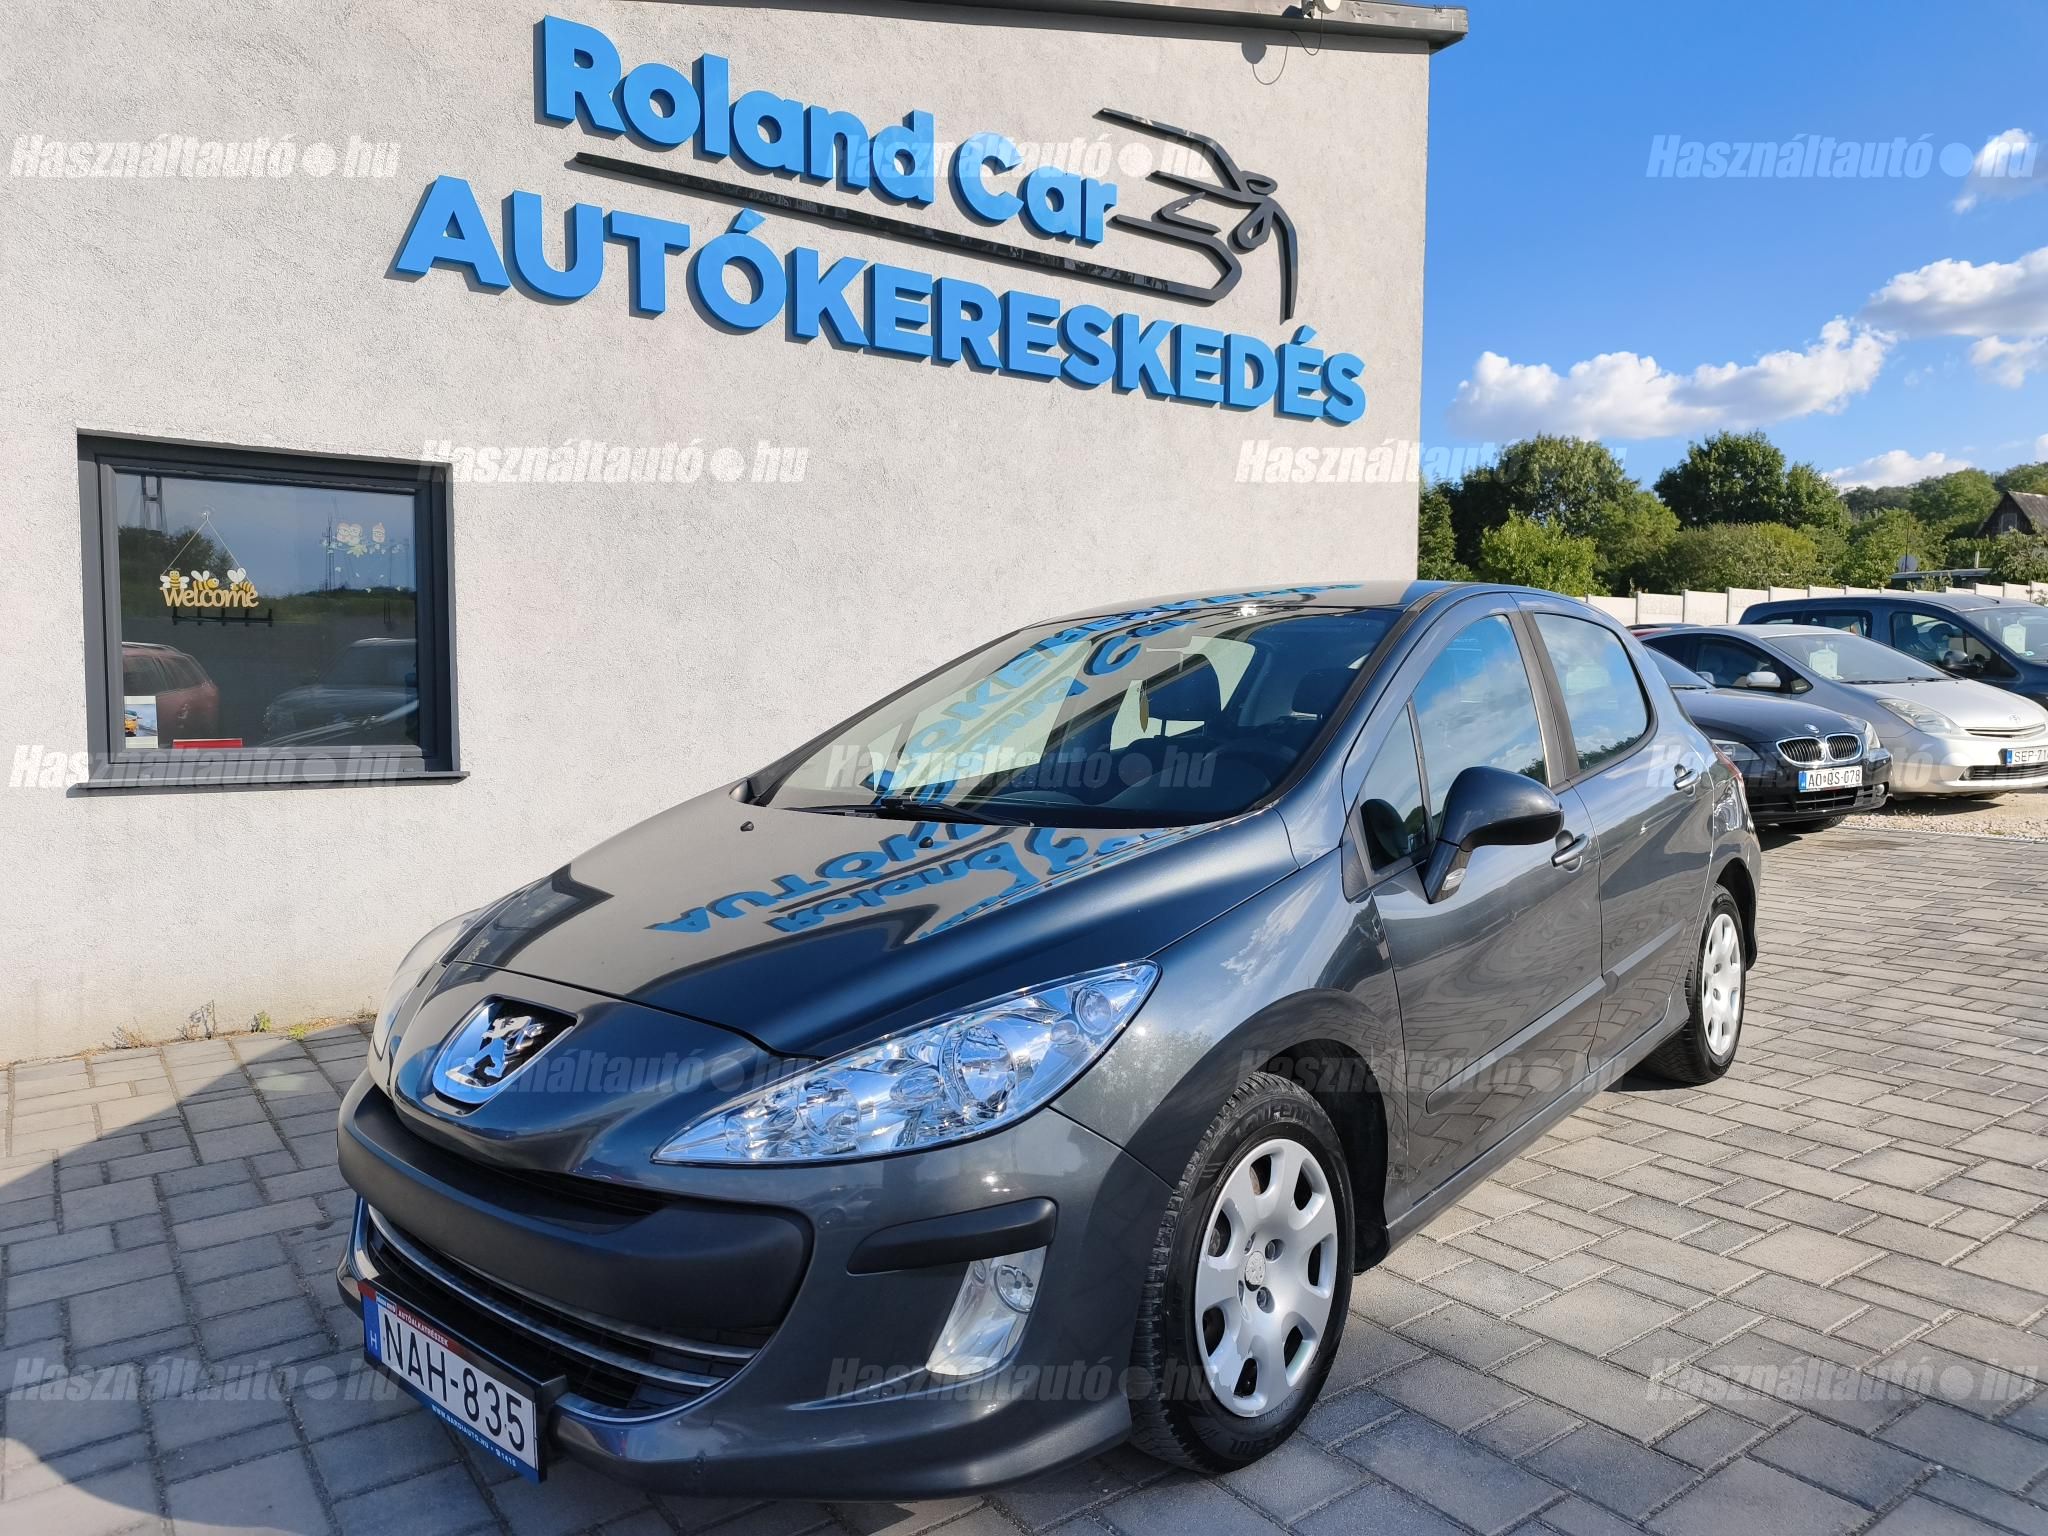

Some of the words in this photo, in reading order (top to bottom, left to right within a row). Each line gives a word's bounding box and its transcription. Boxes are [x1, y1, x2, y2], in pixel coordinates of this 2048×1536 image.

[540, 14, 935, 205] Roland
[950, 130, 1118, 244] Car
[394, 174, 1367, 424] AUTÓKERESKEDÉS
[160, 585, 259, 608] Welcome
[2014, 749, 2048, 763] SEP-71
[383, 1313, 525, 1452] NAH-835
